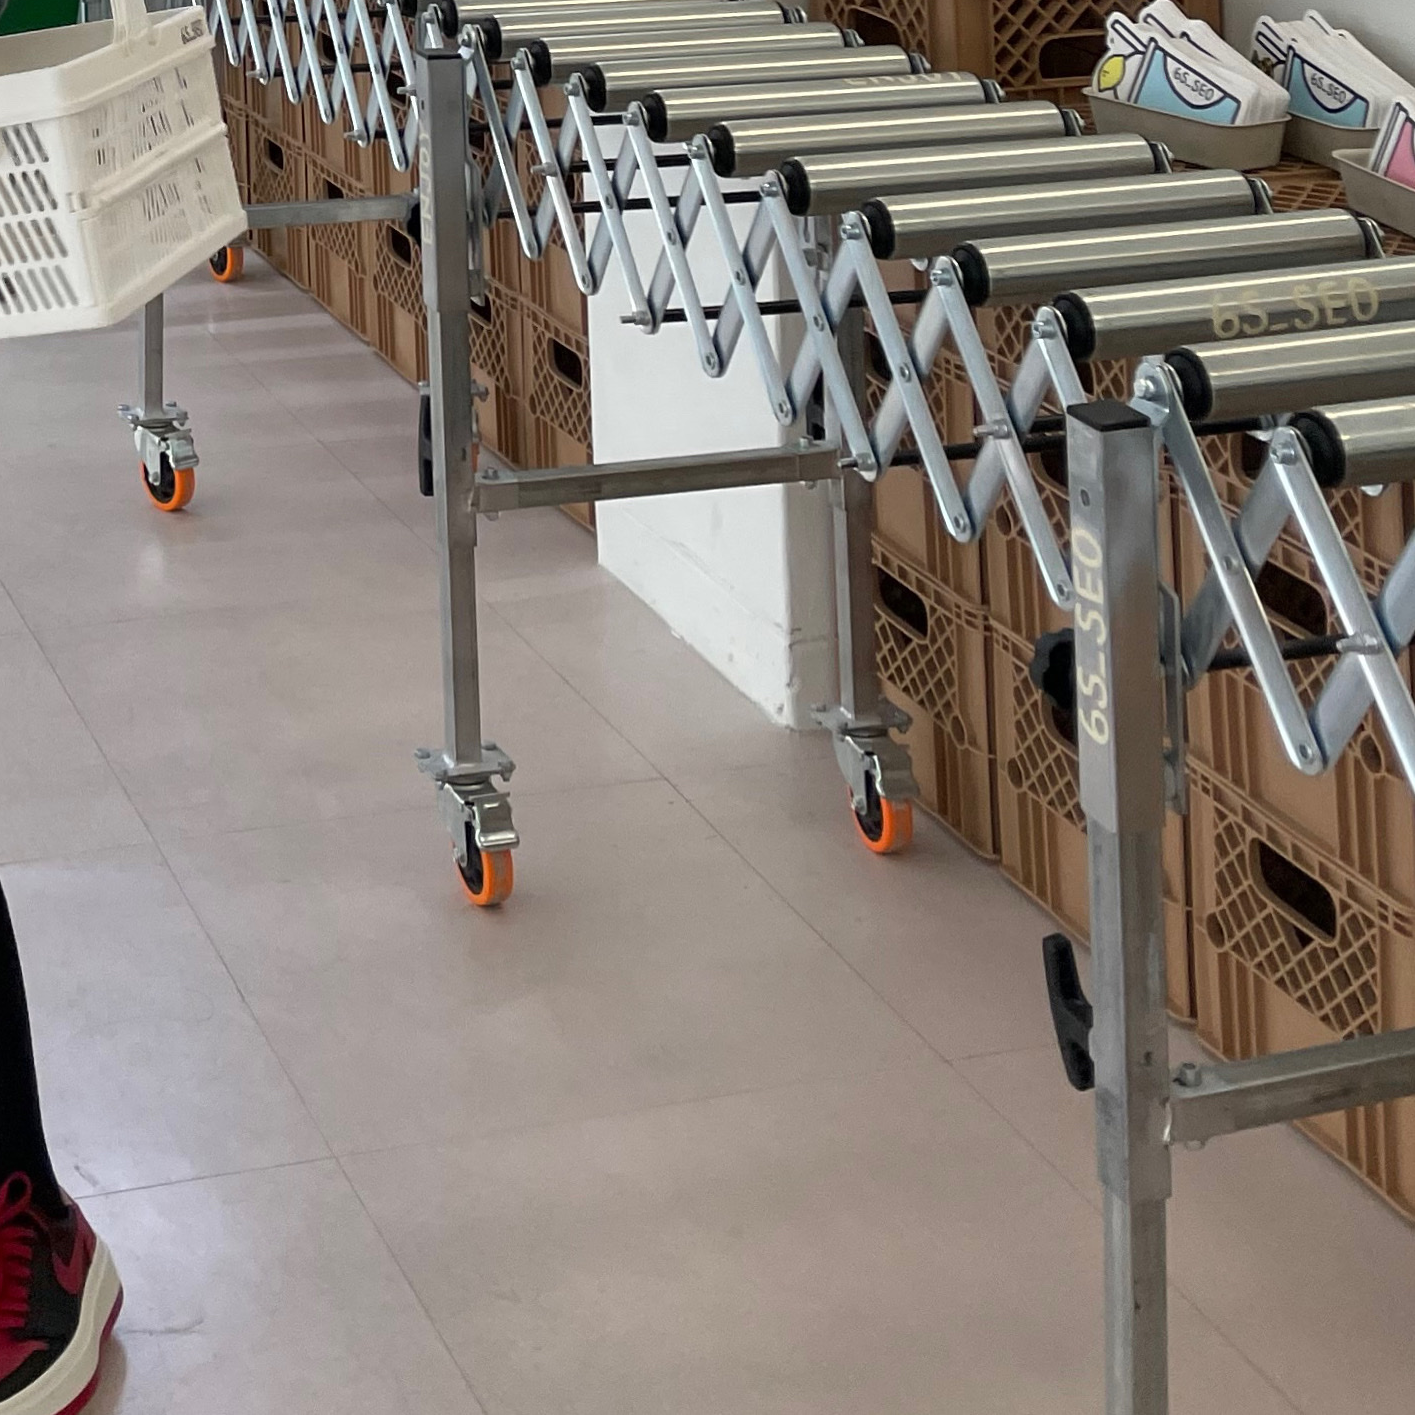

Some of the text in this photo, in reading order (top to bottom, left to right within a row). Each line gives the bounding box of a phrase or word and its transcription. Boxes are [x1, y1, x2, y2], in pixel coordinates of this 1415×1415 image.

[1173, 67, 1215, 102] 6S_SEO
[1310, 72, 1347, 105] 6S_SEO
[1212, 276, 1379, 340] 6S_SEO
[1072, 528, 1109, 746] 6S_SEO
